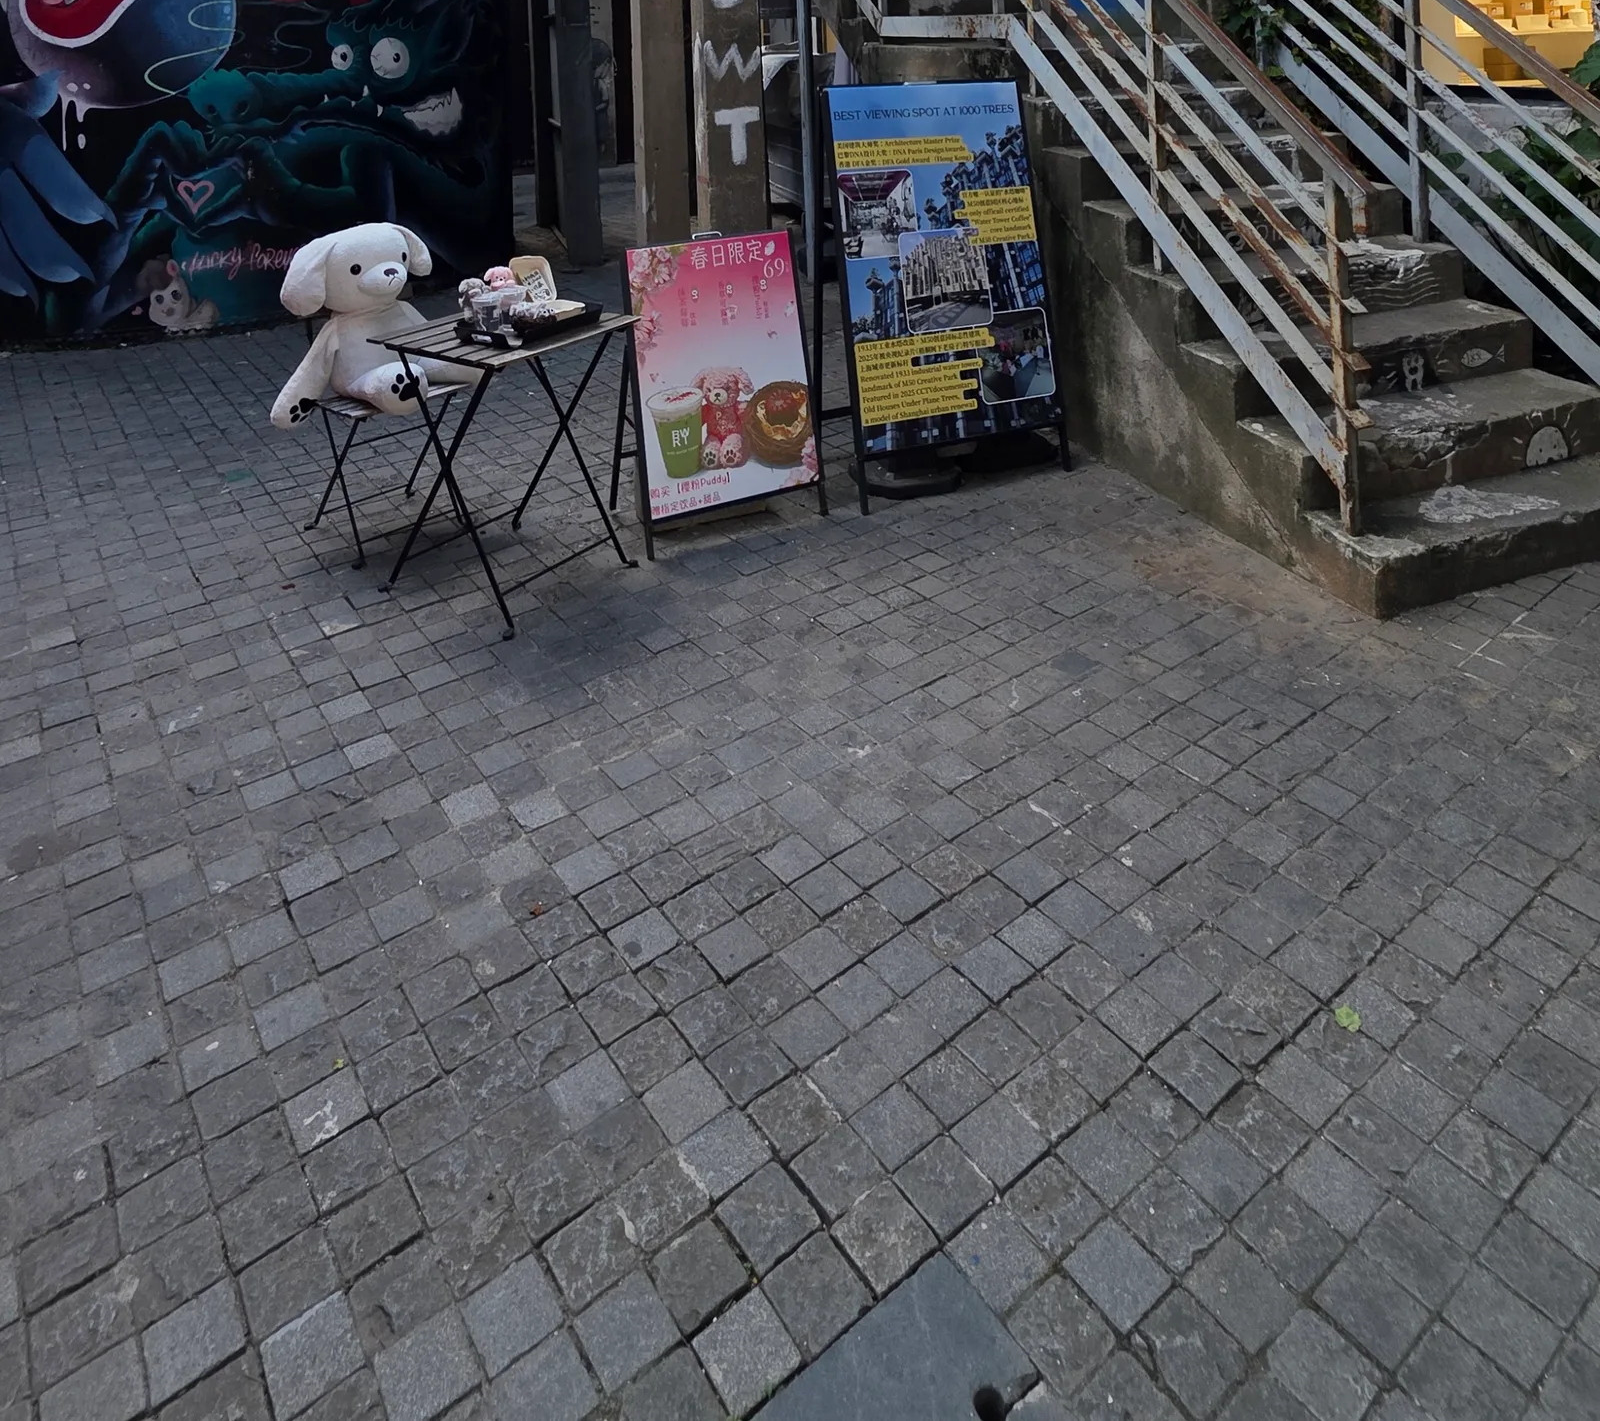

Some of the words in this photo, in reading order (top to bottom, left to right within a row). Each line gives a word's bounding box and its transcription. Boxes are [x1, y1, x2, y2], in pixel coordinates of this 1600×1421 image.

[834, 110, 861, 121] BEST
[863, 108, 910, 120] VIEWING
[912, 107, 940, 118] SPOT
[943, 106, 956, 116] AT
[959, 105, 981, 115] 1000
[981, 104, 1015, 115] TREES
[884, 139, 922, 147] Architecture
[892, 148, 907, 156] DNA
[908, 147, 923, 155] Paris
[895, 157, 910, 165] Gold
[911, 156, 930, 164] Award
[956, 210, 968, 218] The
[969, 209, 981, 218] only
[1005, 205, 1030, 214] certified
[1004, 224, 1032, 232] landmark
[691, 240, 763, 270] 春日限定
[763, 258, 785, 278] 69
[860, 371, 894, 383] Renovated
[895, 369, 910, 378] 1933
[911, 364, 942, 375] industrial
[943, 363, 960, 371] water
[861, 382, 893, 393] landmark
[902, 379, 916, 387] M50
[917, 375, 942, 385] Creative
[943, 372, 958, 381] Park
[862, 392, 892, 404] Featured
[900, 389, 916, 398] 2025
[863, 405, 876, 414] Old
[876, 404, 900, 412] Houses
[901, 399, 921, 409] Under
[922, 397, 940, 405] Plane
[870, 413, 890, 424] model
[899, 407, 929, 419] Shanghai
[930, 405, 949, 414] urban
[950, 400, 975, 411] renewal
